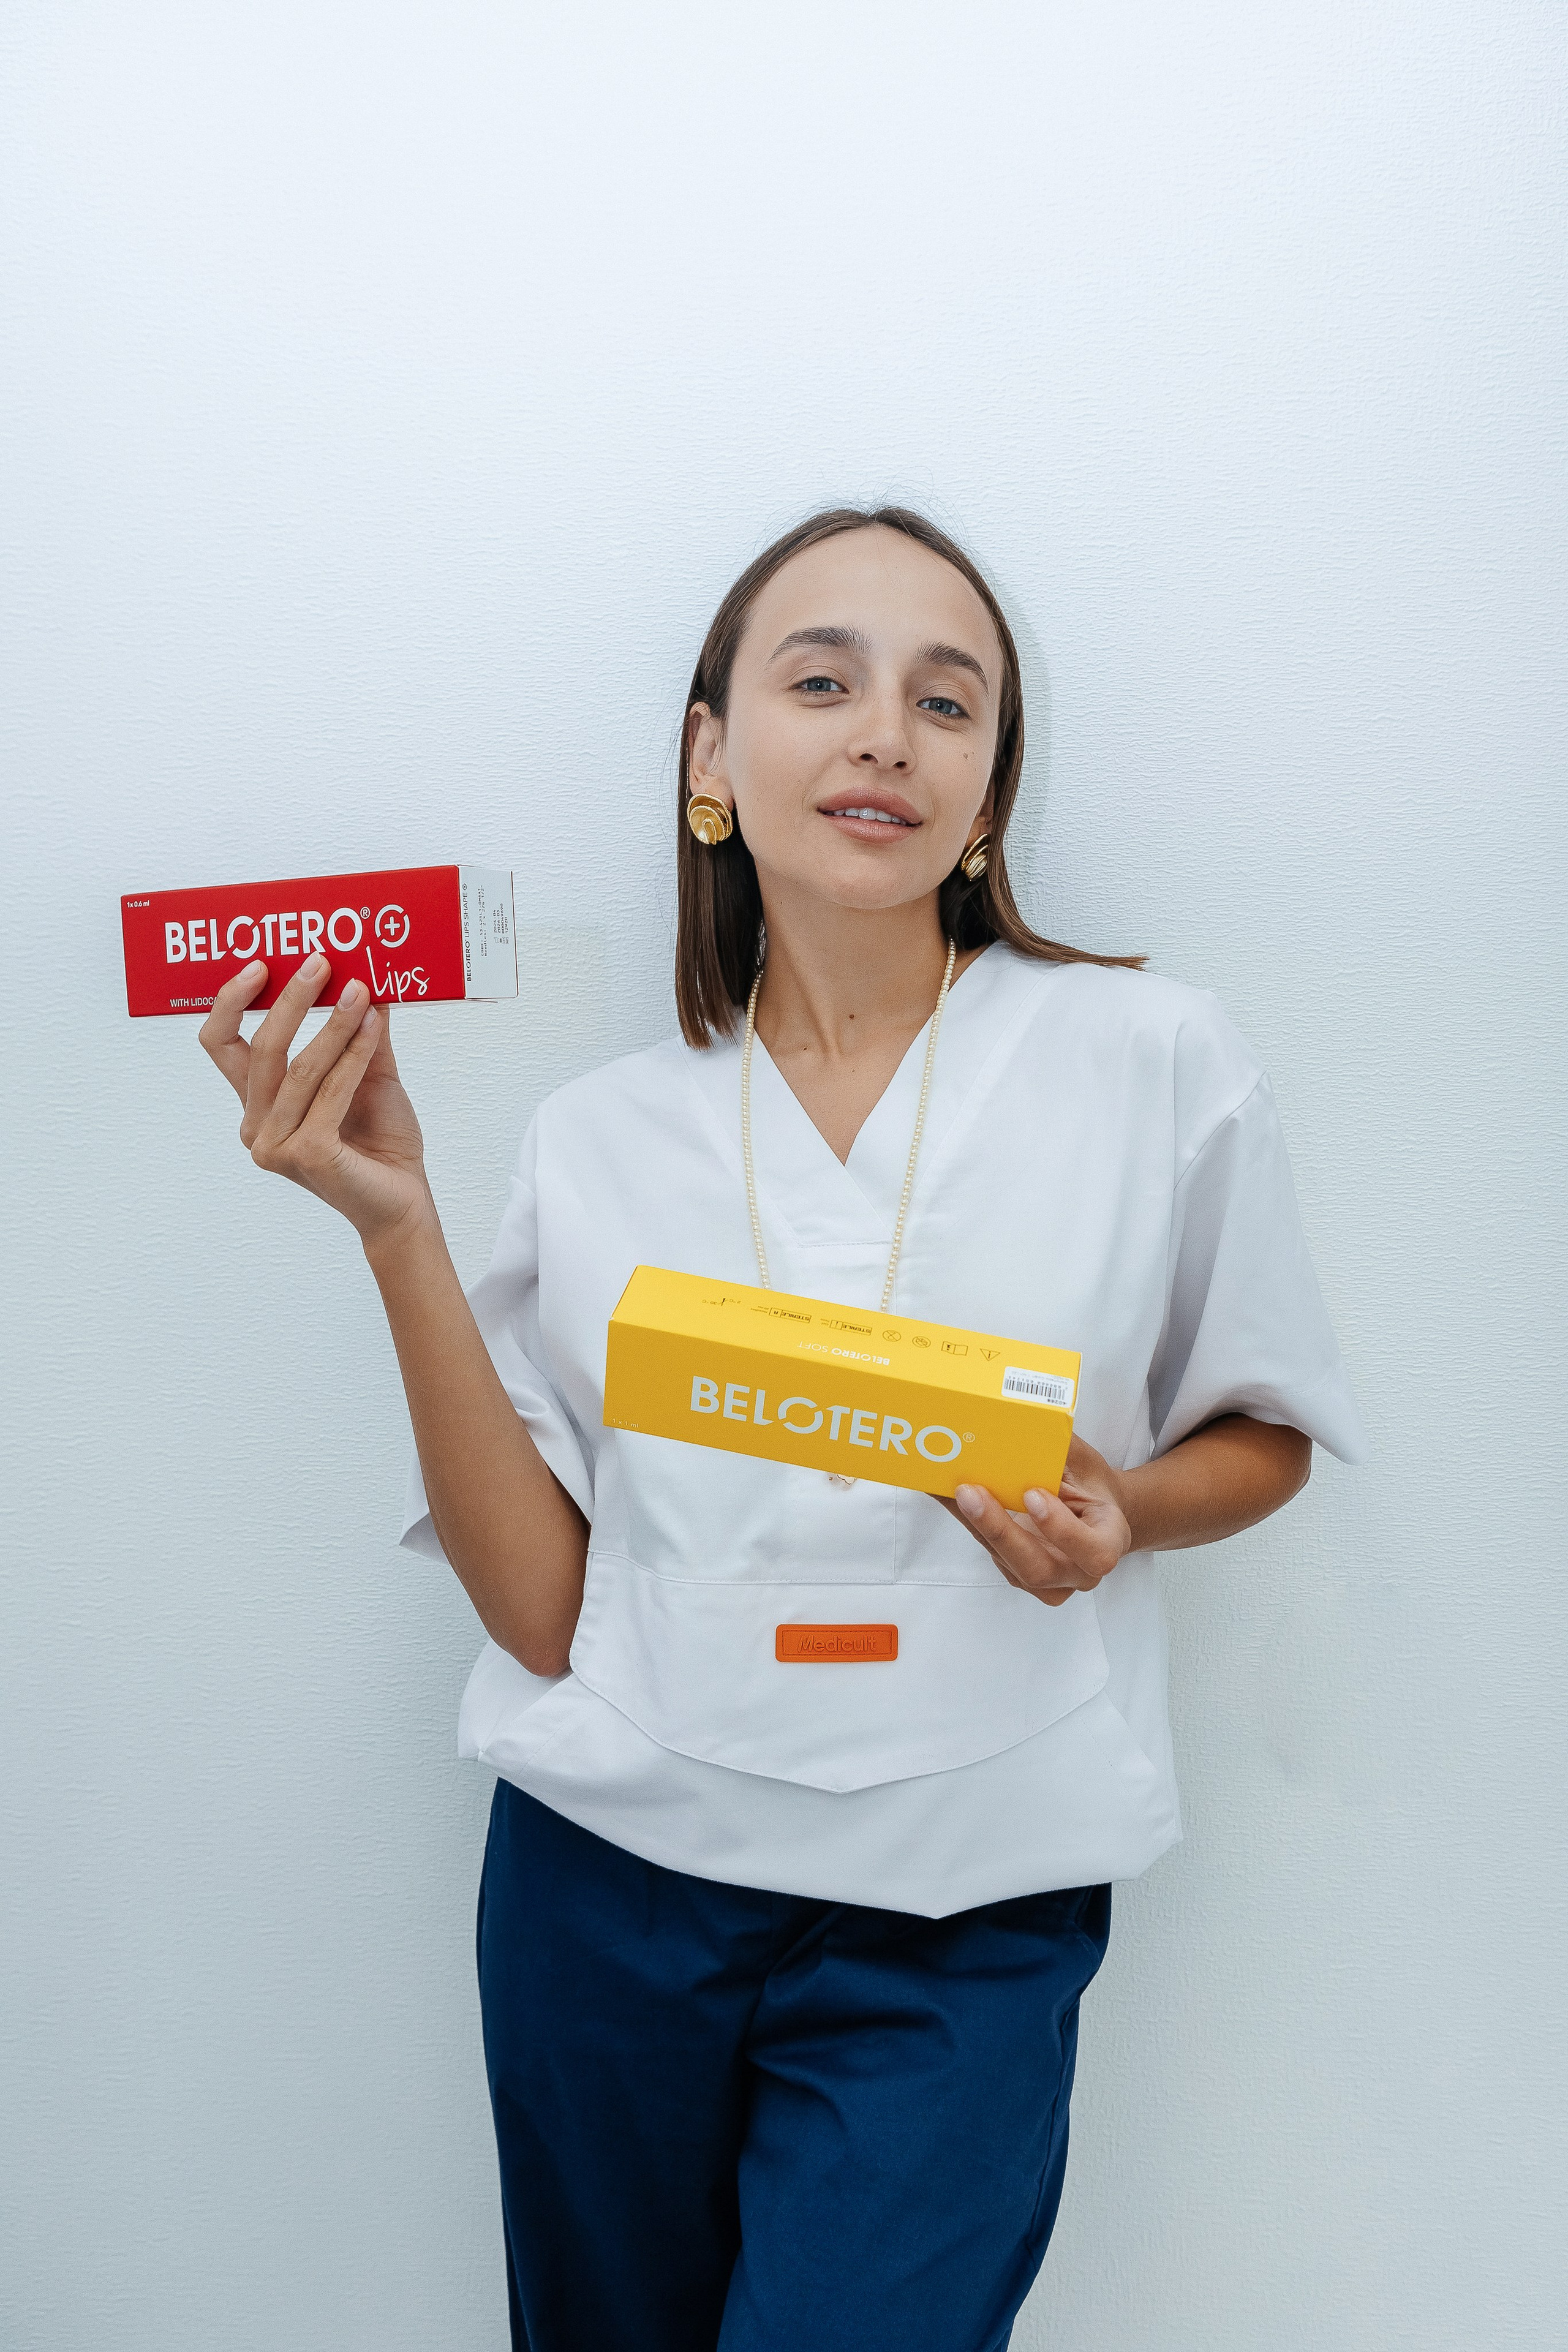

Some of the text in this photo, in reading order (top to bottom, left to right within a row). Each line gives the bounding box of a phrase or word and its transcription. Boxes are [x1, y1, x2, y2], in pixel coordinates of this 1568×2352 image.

[170, 996, 217, 1008] WITH LIDOC
[797, 1341, 890, 1365] BELOTERO SOFT
[797, 1635, 876, 1653] Medicult
